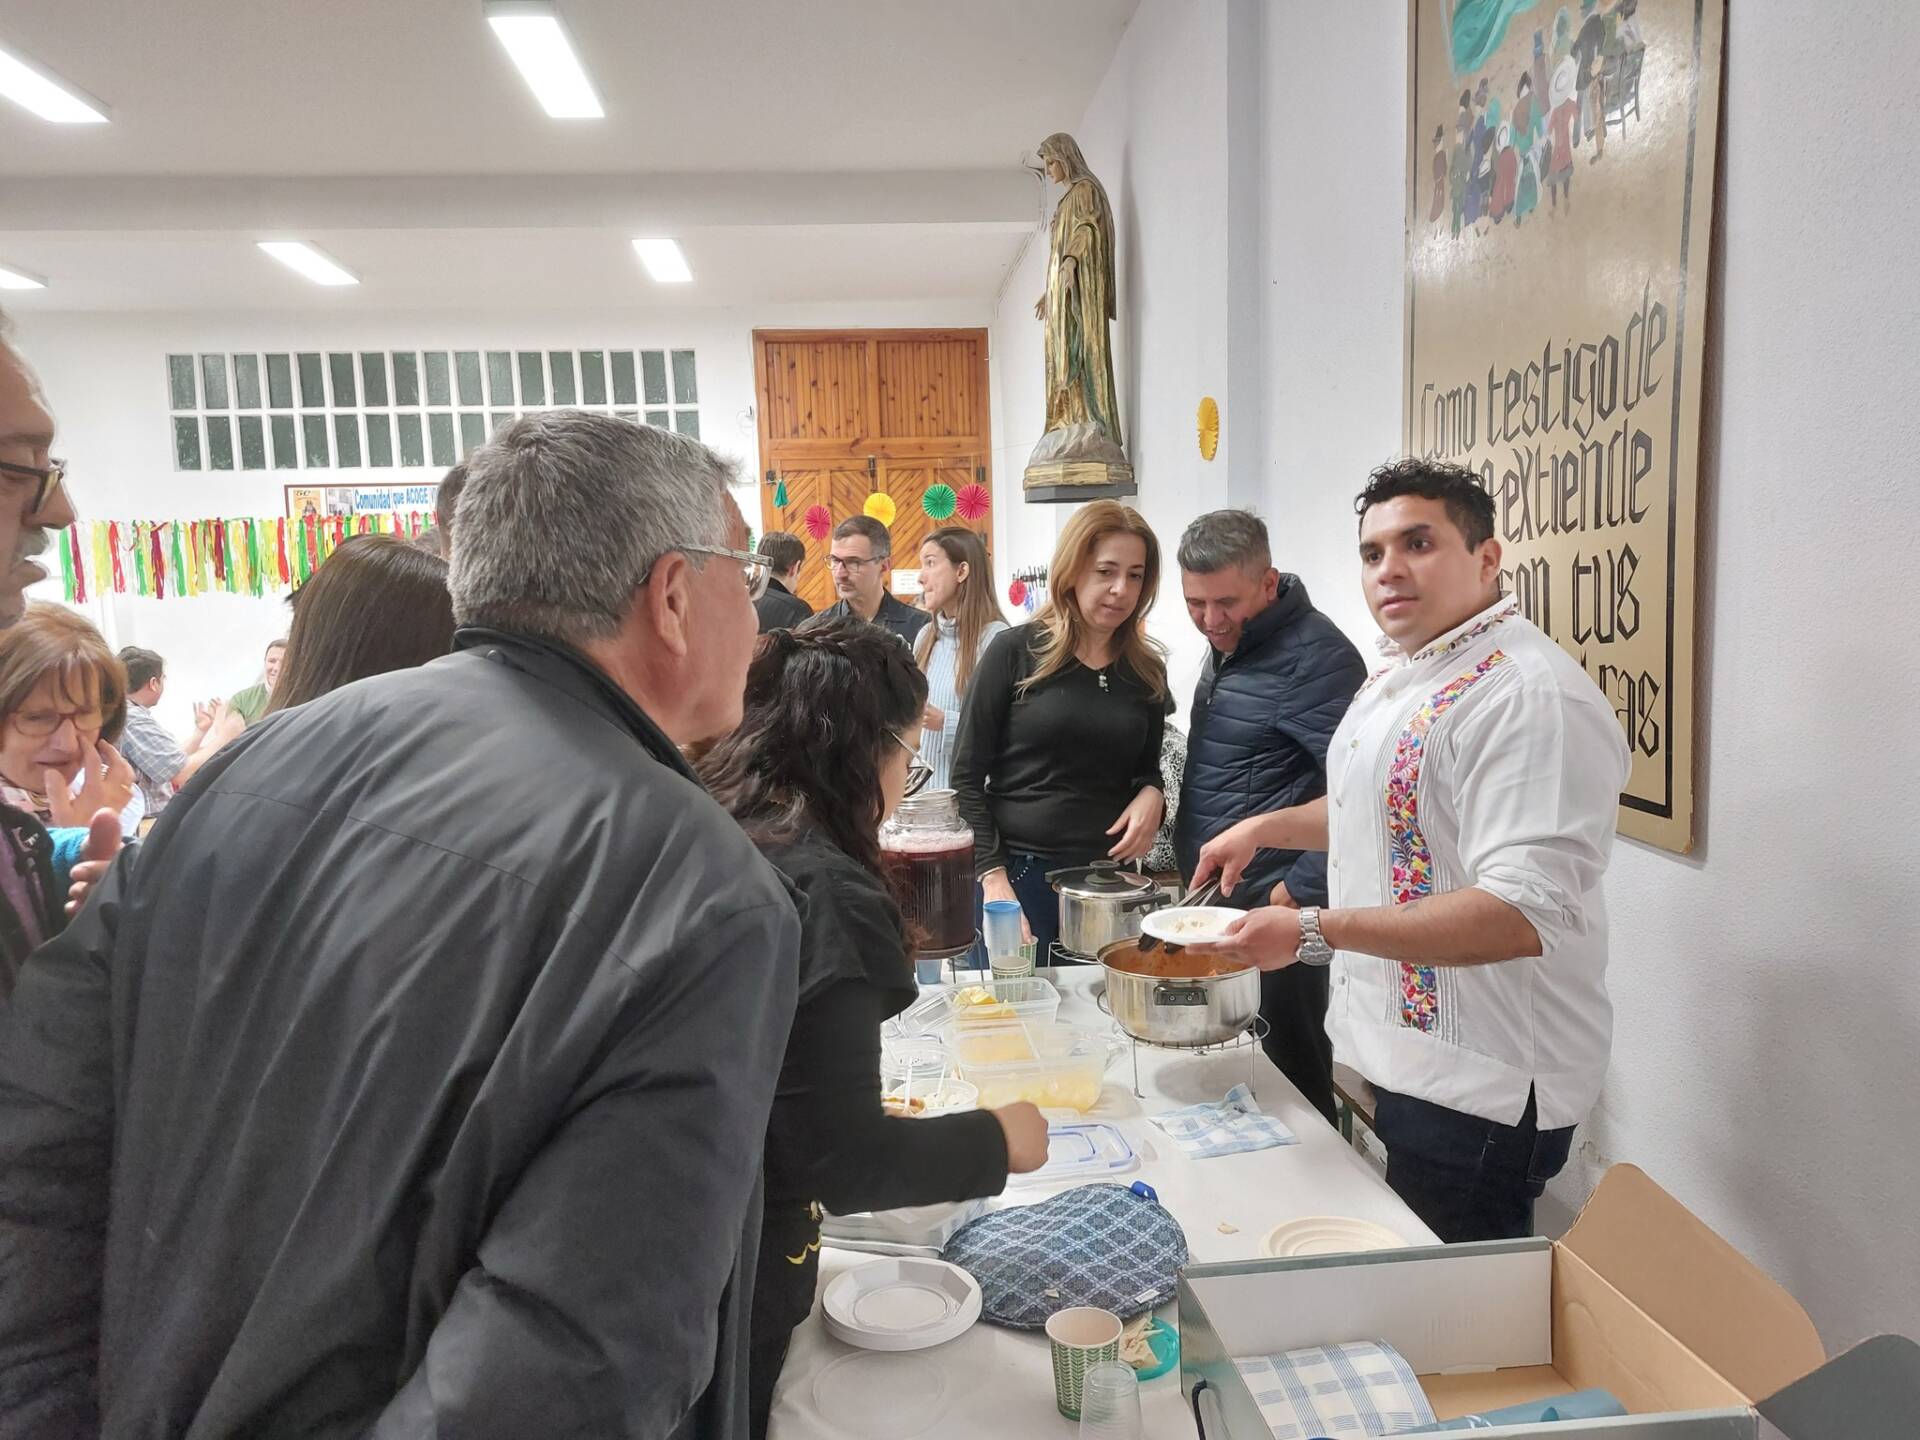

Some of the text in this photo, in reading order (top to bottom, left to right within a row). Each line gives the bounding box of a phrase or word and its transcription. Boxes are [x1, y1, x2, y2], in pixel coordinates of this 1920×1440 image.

[1420, 276, 1668, 460] Como testigo de
[354, 488, 391, 510] Comunidad
[393, 492, 405, 510] que
[406, 487, 429, 505] ACOGE
[1501, 418, 1653, 544] extiende
[1571, 542, 1641, 646] tus
